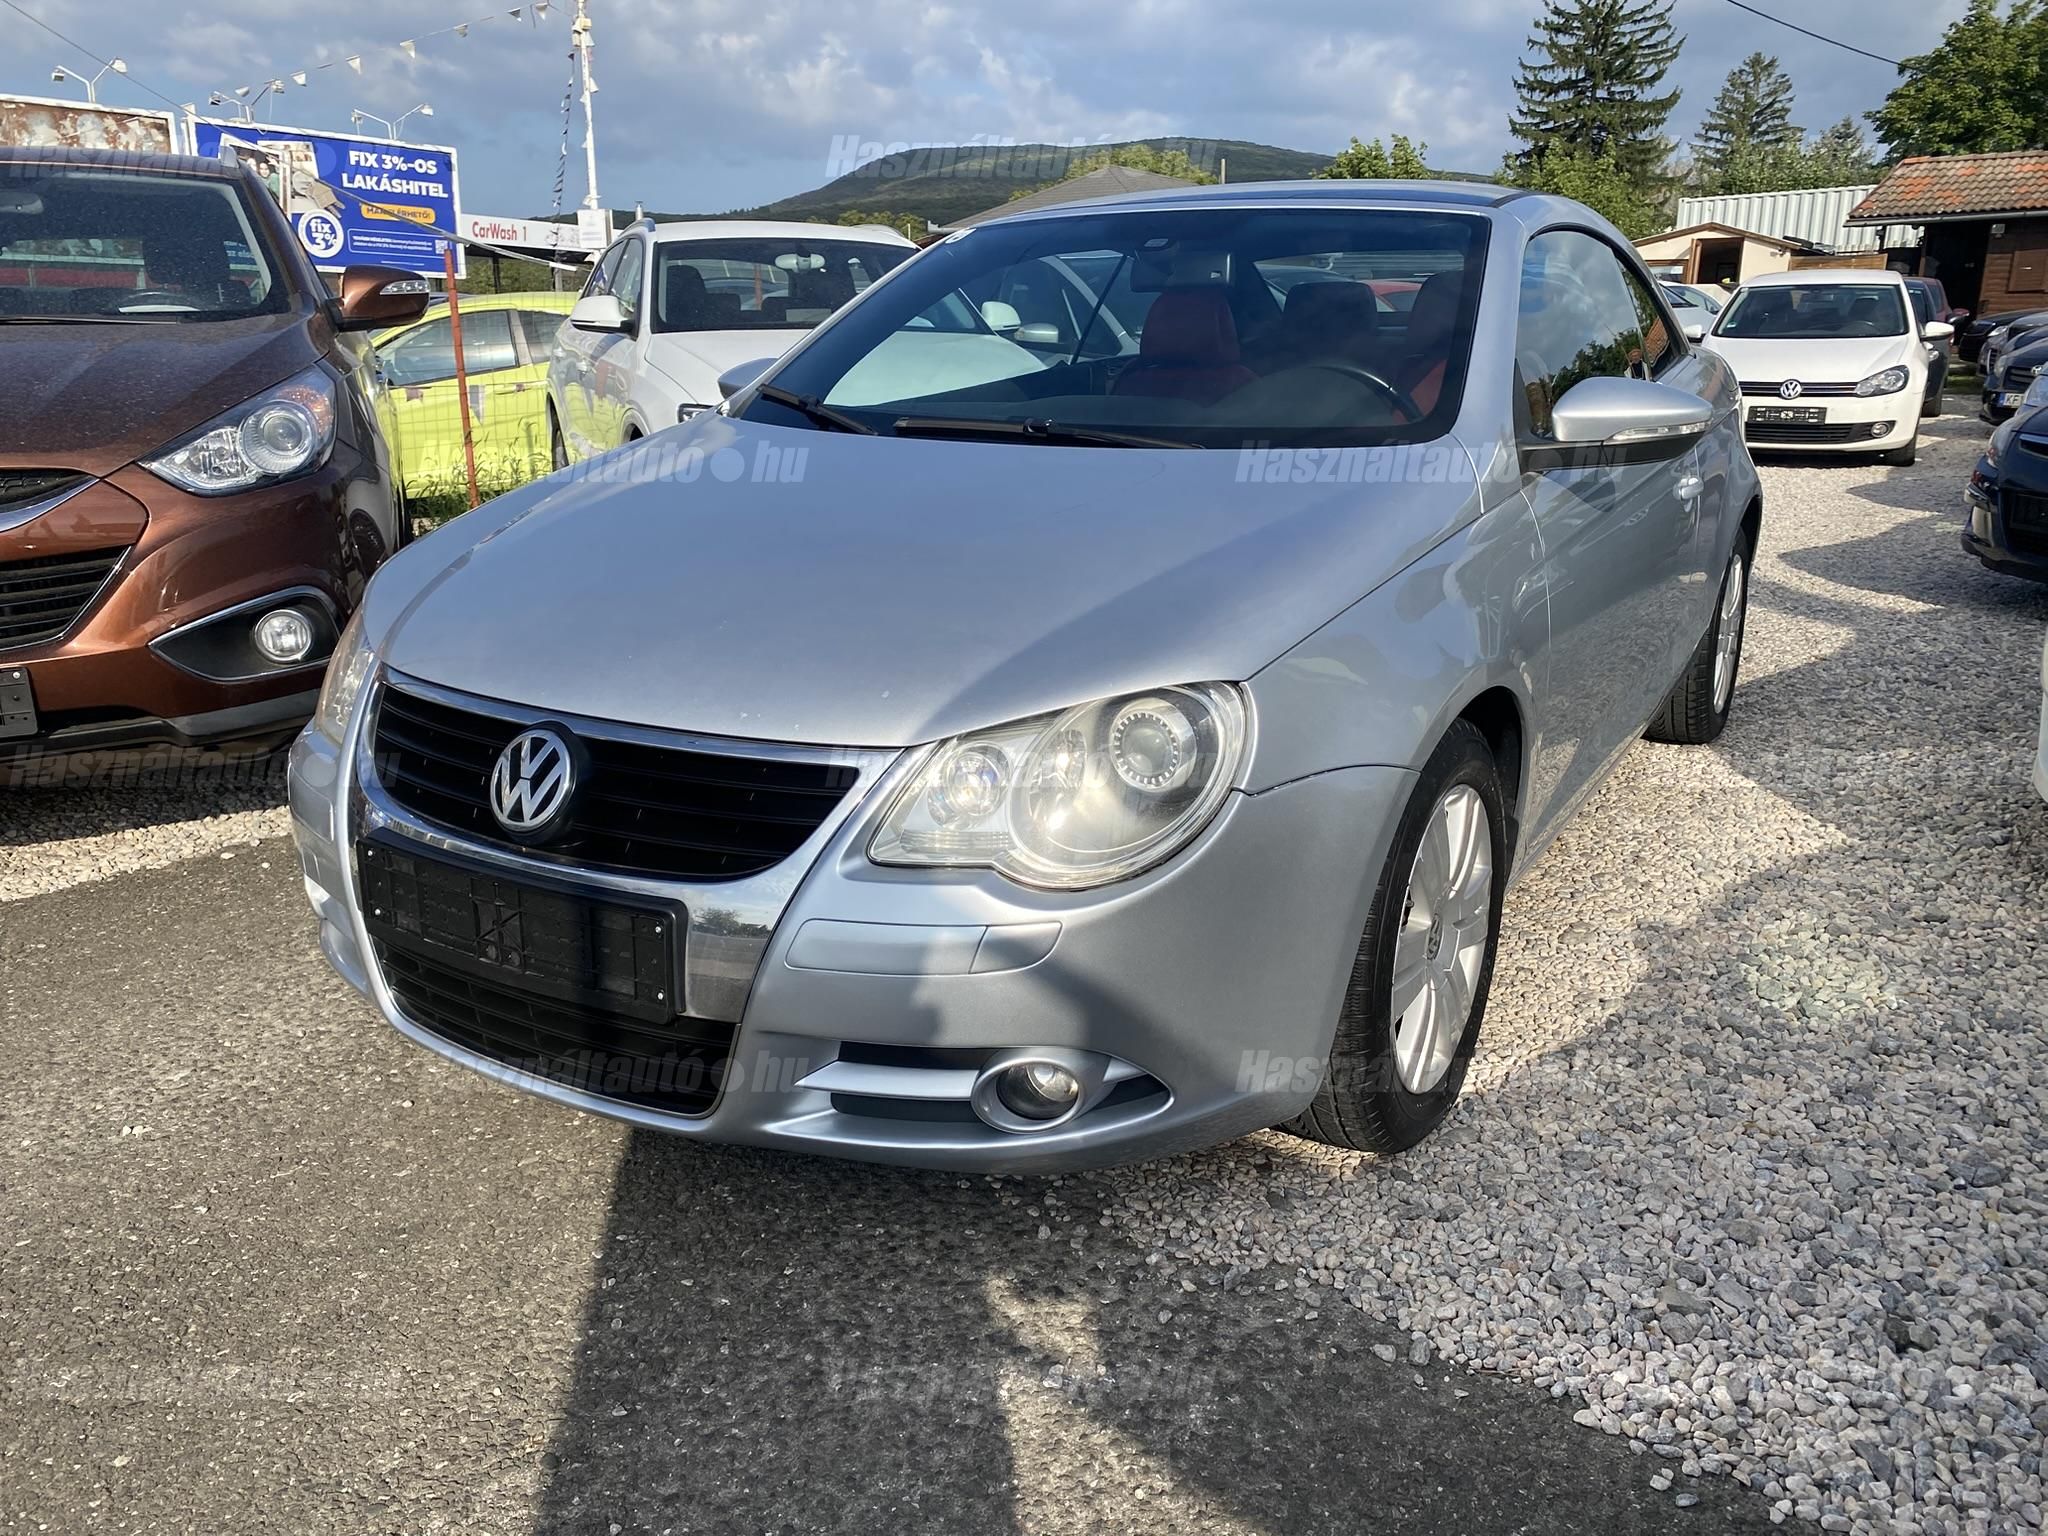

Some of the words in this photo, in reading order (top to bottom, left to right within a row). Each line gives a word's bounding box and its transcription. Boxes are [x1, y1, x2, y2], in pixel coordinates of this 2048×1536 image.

[349, 150, 378, 168] FIX
[382, 154, 437, 174] 3%-OS
[342, 173, 449, 198] LAKÁSHITEL
[310, 219, 331, 233] fix
[472, 221, 517, 241] CarWash
[522, 226, 527, 241] 1
[312, 233, 336, 250] 3%
